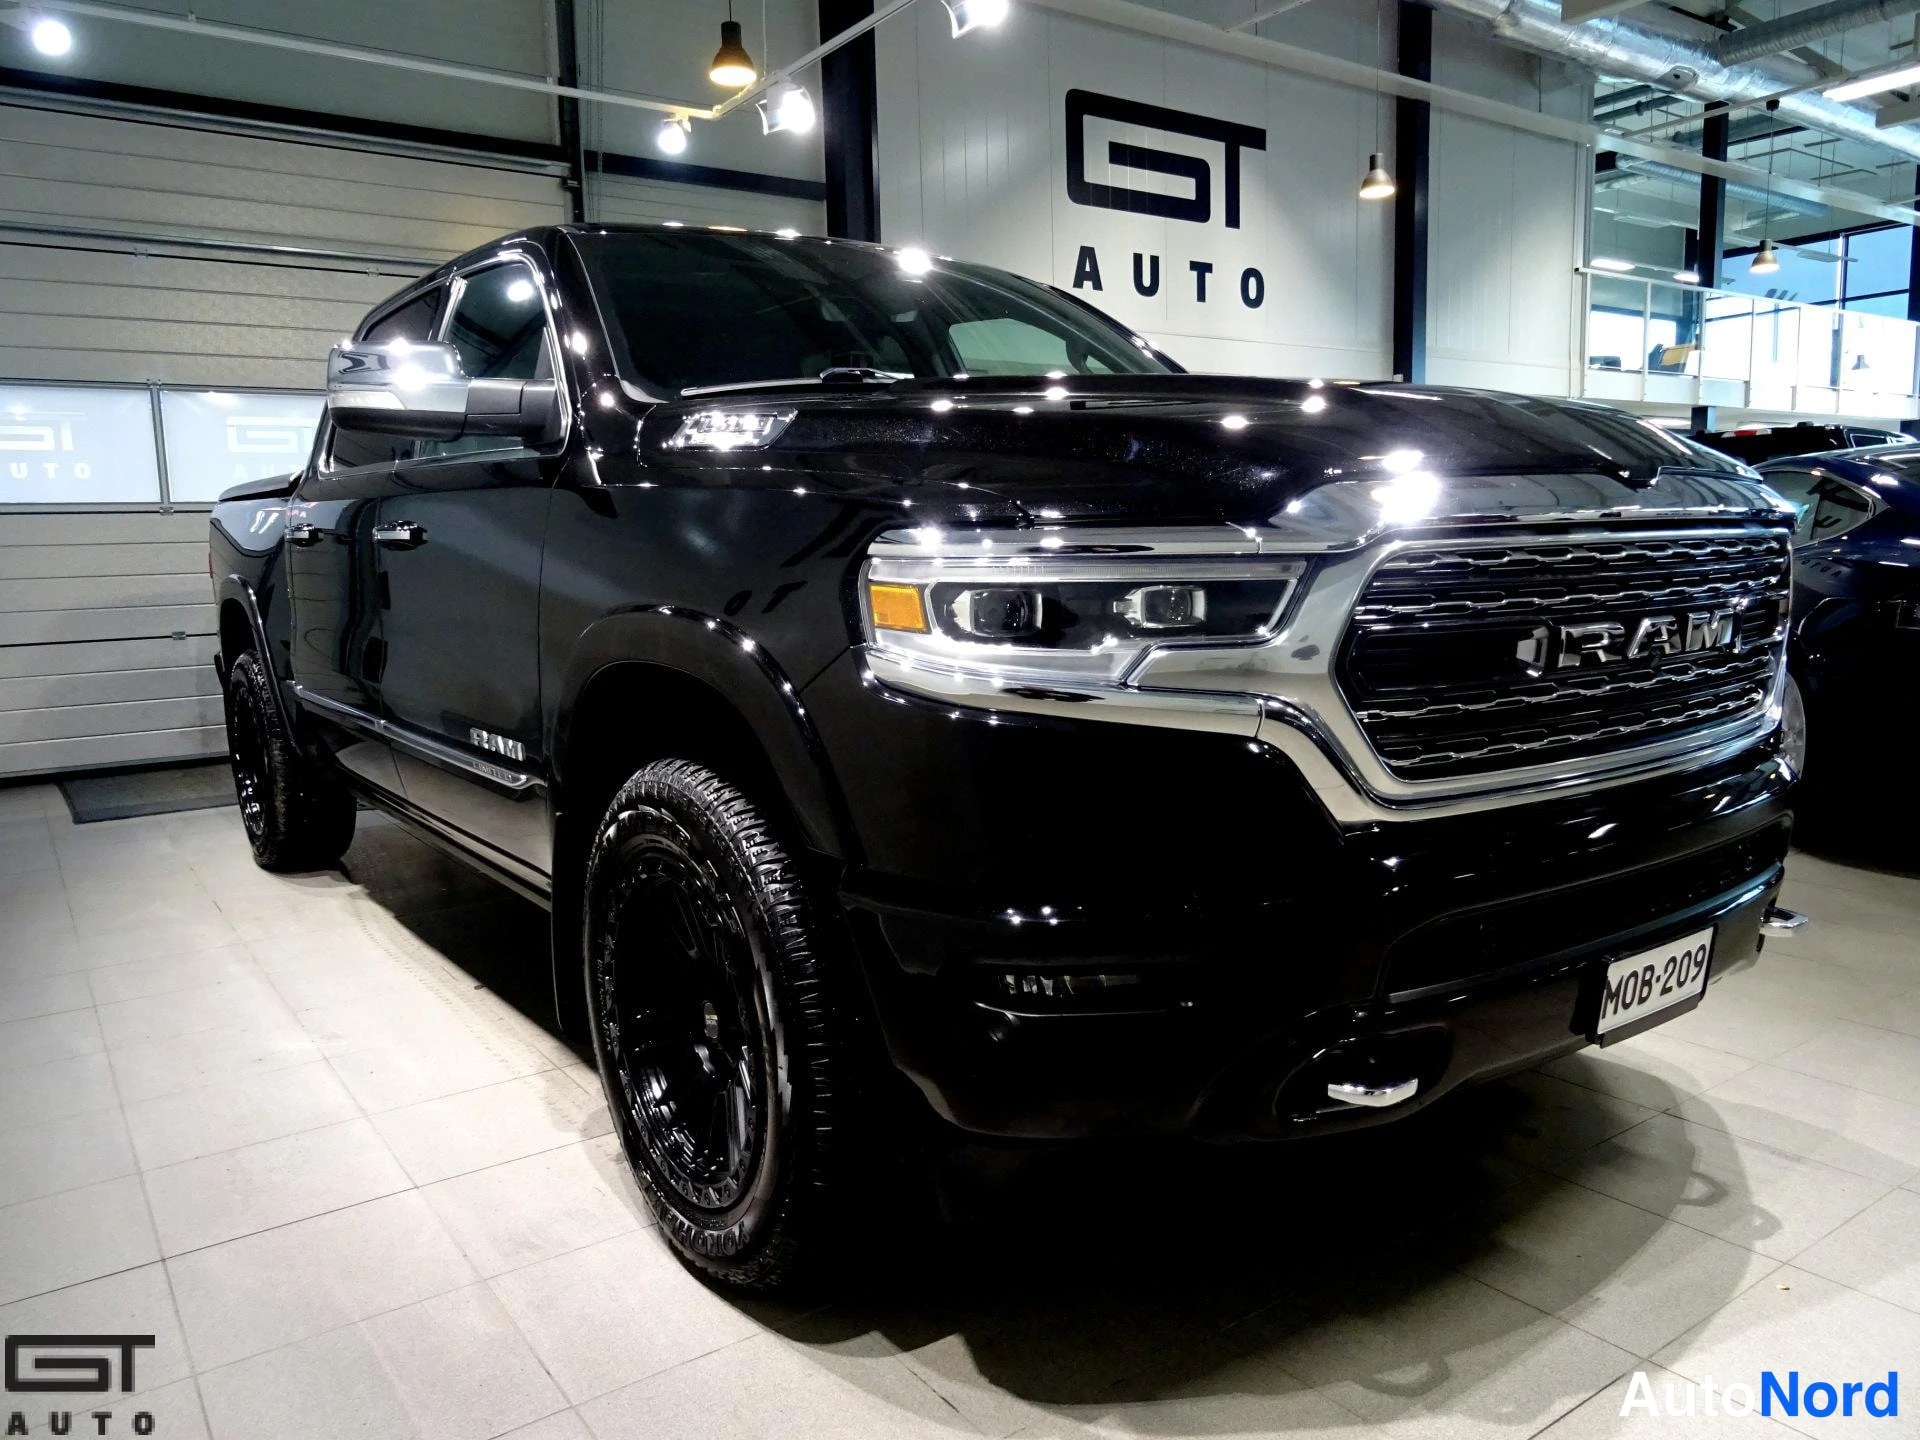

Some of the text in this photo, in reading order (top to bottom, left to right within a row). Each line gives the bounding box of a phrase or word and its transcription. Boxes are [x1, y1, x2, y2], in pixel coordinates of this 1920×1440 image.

[1072, 245, 1265, 309] AUTO
[9, 461, 91, 479] UTO
[1557, 606, 1742, 668] RAM
[469, 727, 526, 762] RAM
[1601, 943, 1707, 1020] MOB-209
